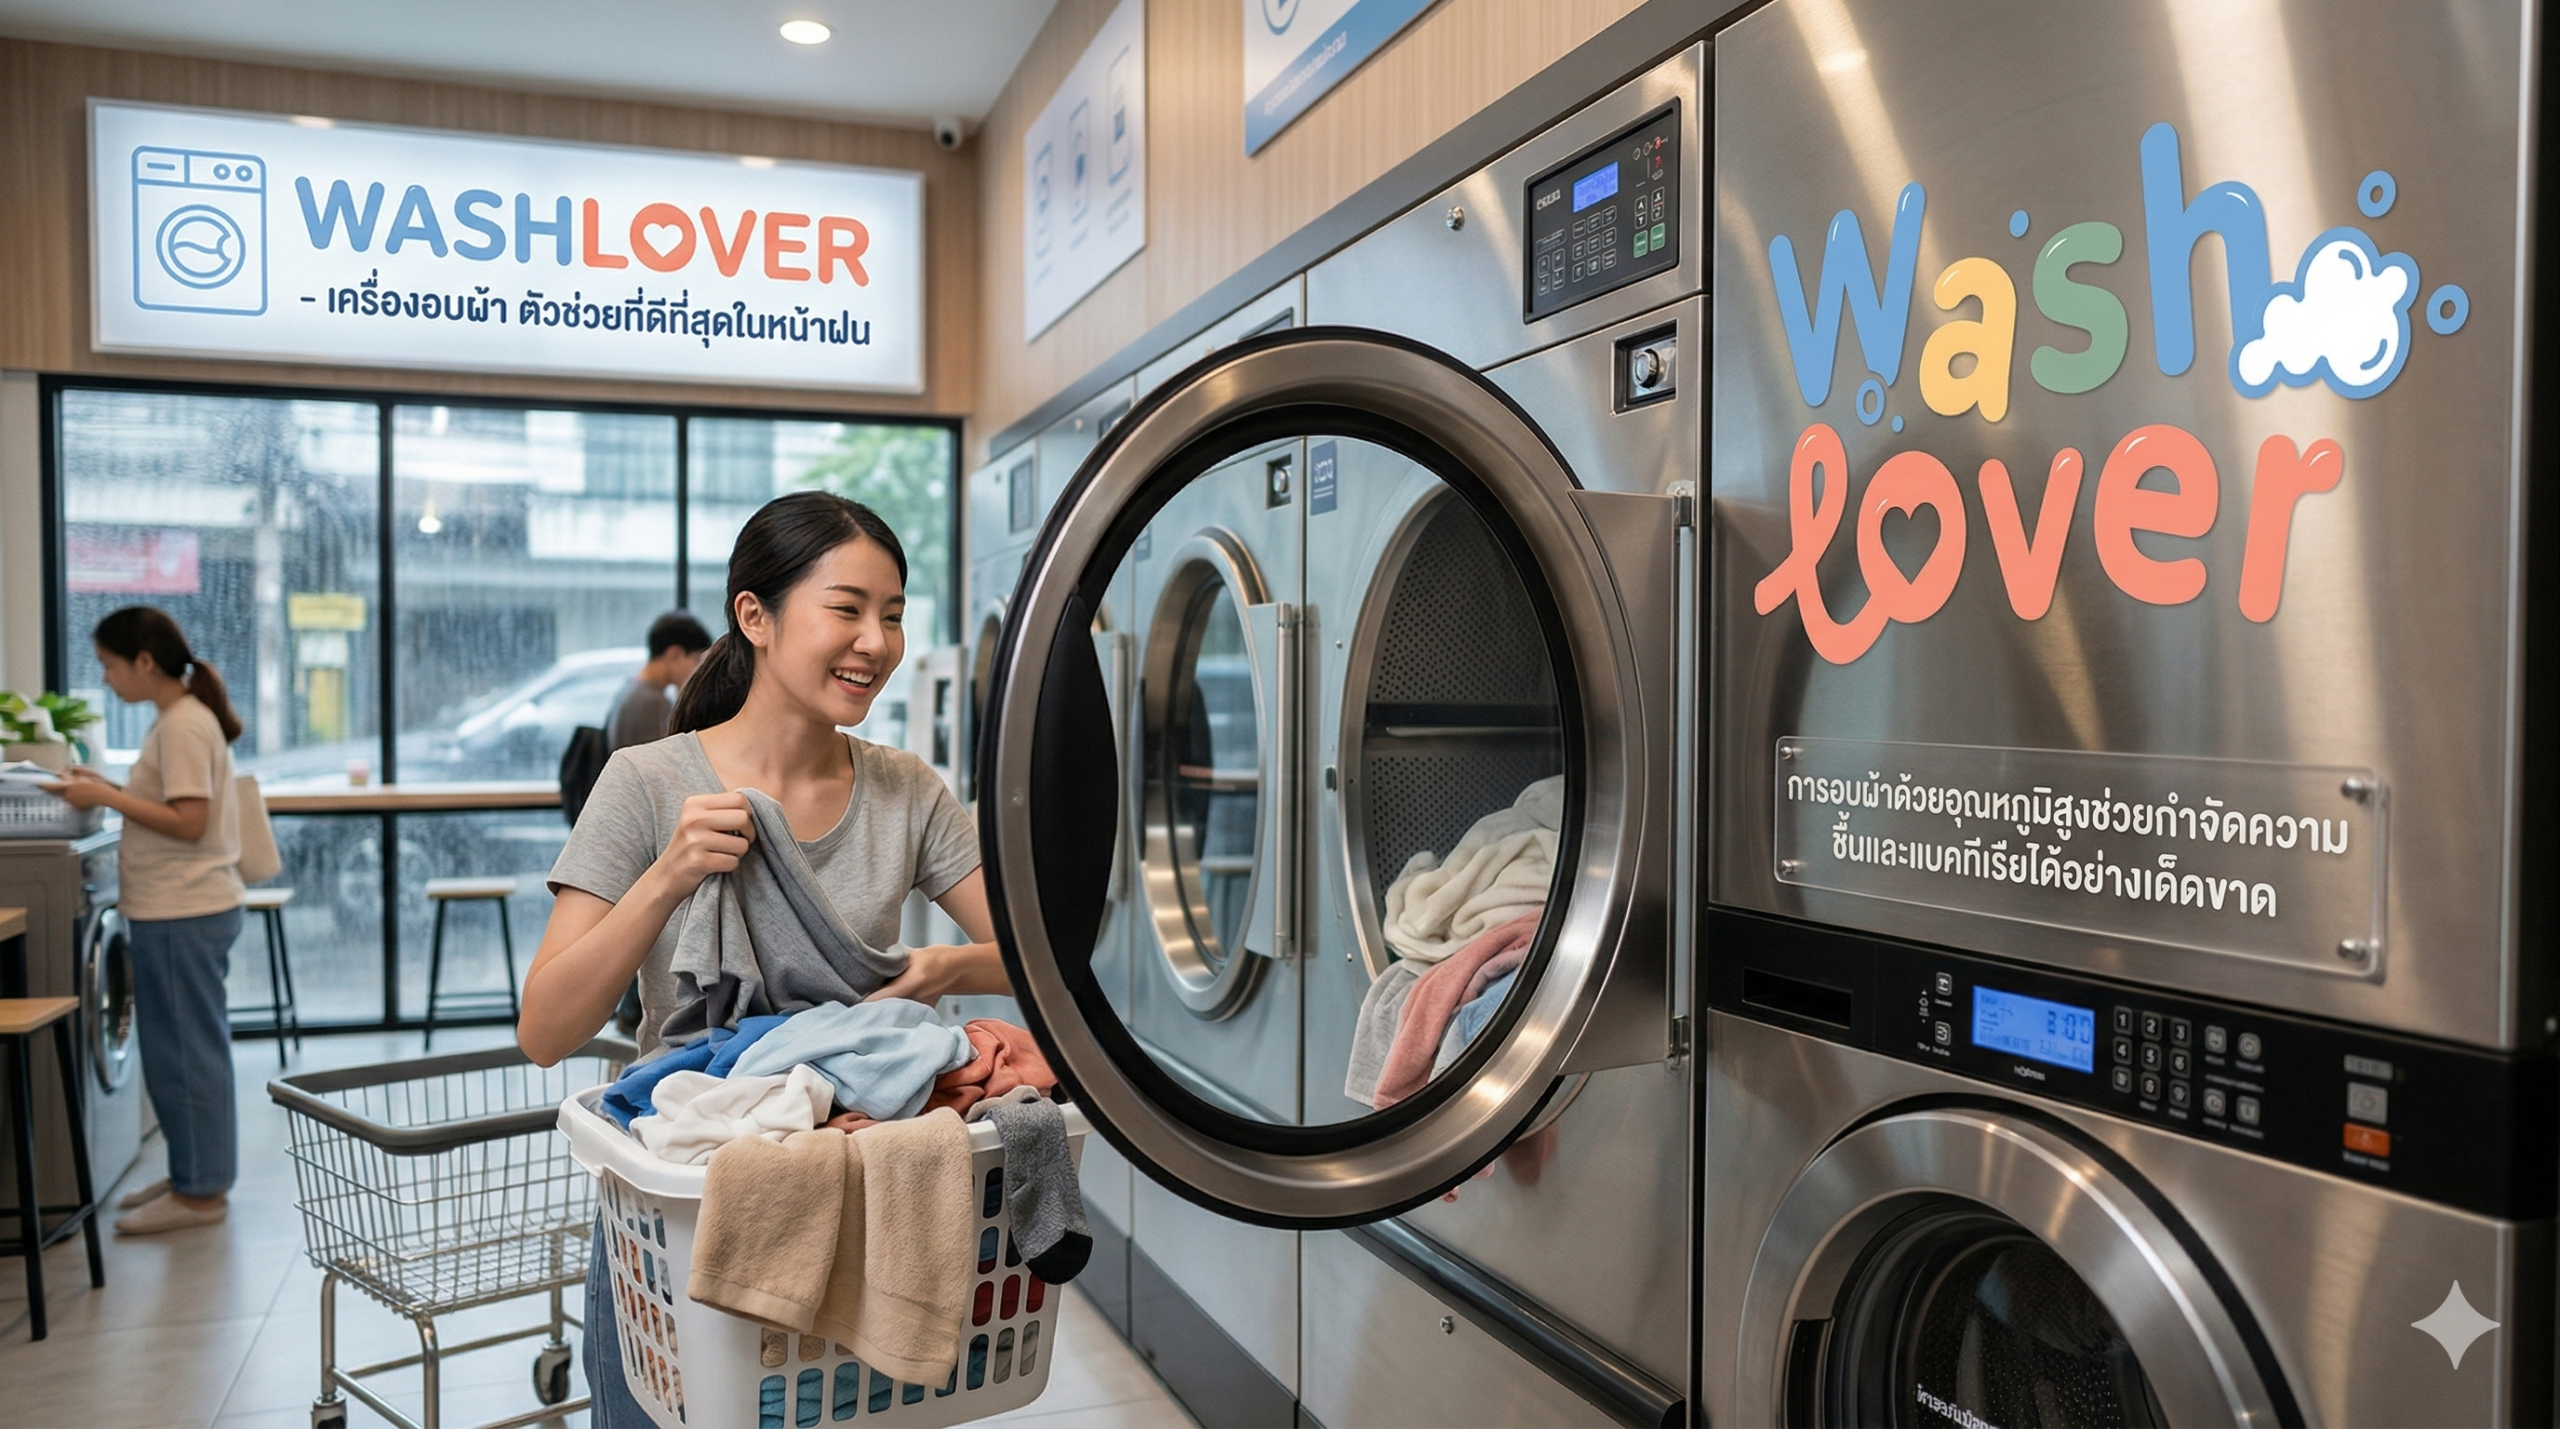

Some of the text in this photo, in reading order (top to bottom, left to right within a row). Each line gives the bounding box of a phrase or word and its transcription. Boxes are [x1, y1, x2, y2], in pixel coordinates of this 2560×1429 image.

[294, 176, 870, 288] WASHLOVER
[1768, 122, 2271, 423] Wash
[328, 268, 508, 324] เครื่องอบผ้า
[519, 286, 871, 349] ตัวช่วยที่ดีที่สุดในหน้าฝน
[1754, 423, 2345, 665] lover
[1787, 770, 2349, 854] การอบผ้าด้วยอุณหภูมิสูงช่วยกำจัดความ
[2146, 1018, 2156, 1034] 2
